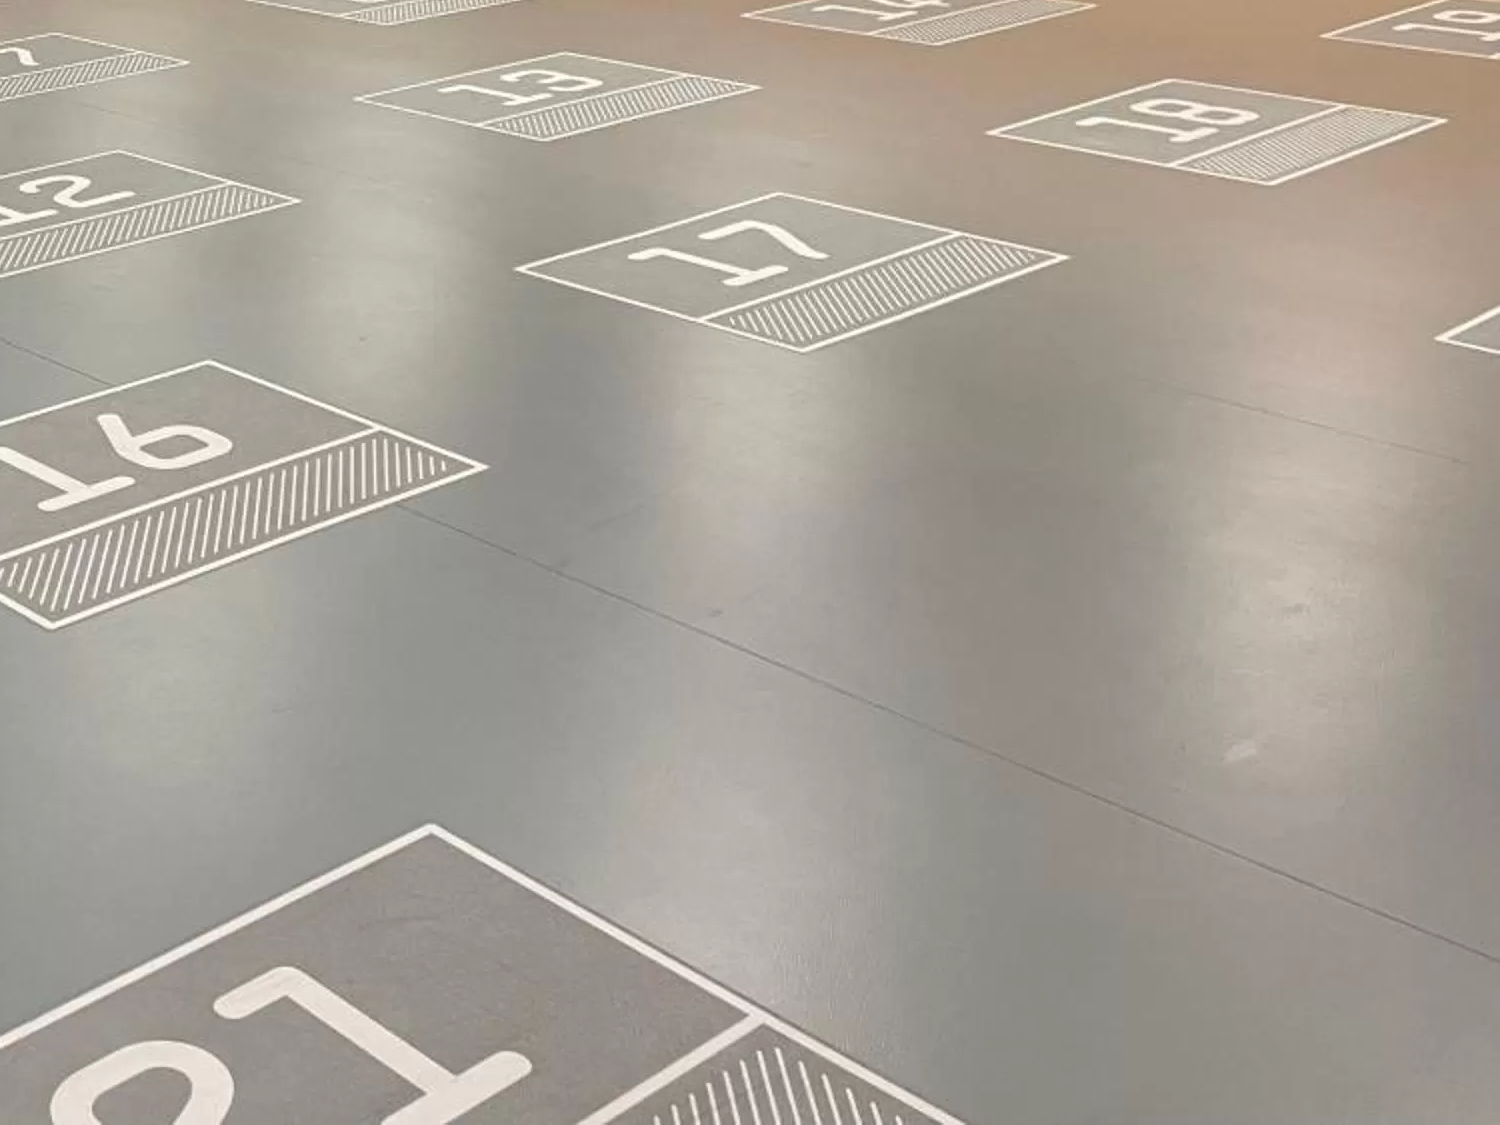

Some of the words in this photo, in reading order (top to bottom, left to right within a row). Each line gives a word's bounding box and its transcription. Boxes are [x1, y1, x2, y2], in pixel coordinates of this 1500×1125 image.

[437, 69, 604, 106] 13
[1075, 98, 1261, 143] 18
[627, 219, 830, 287] 17
